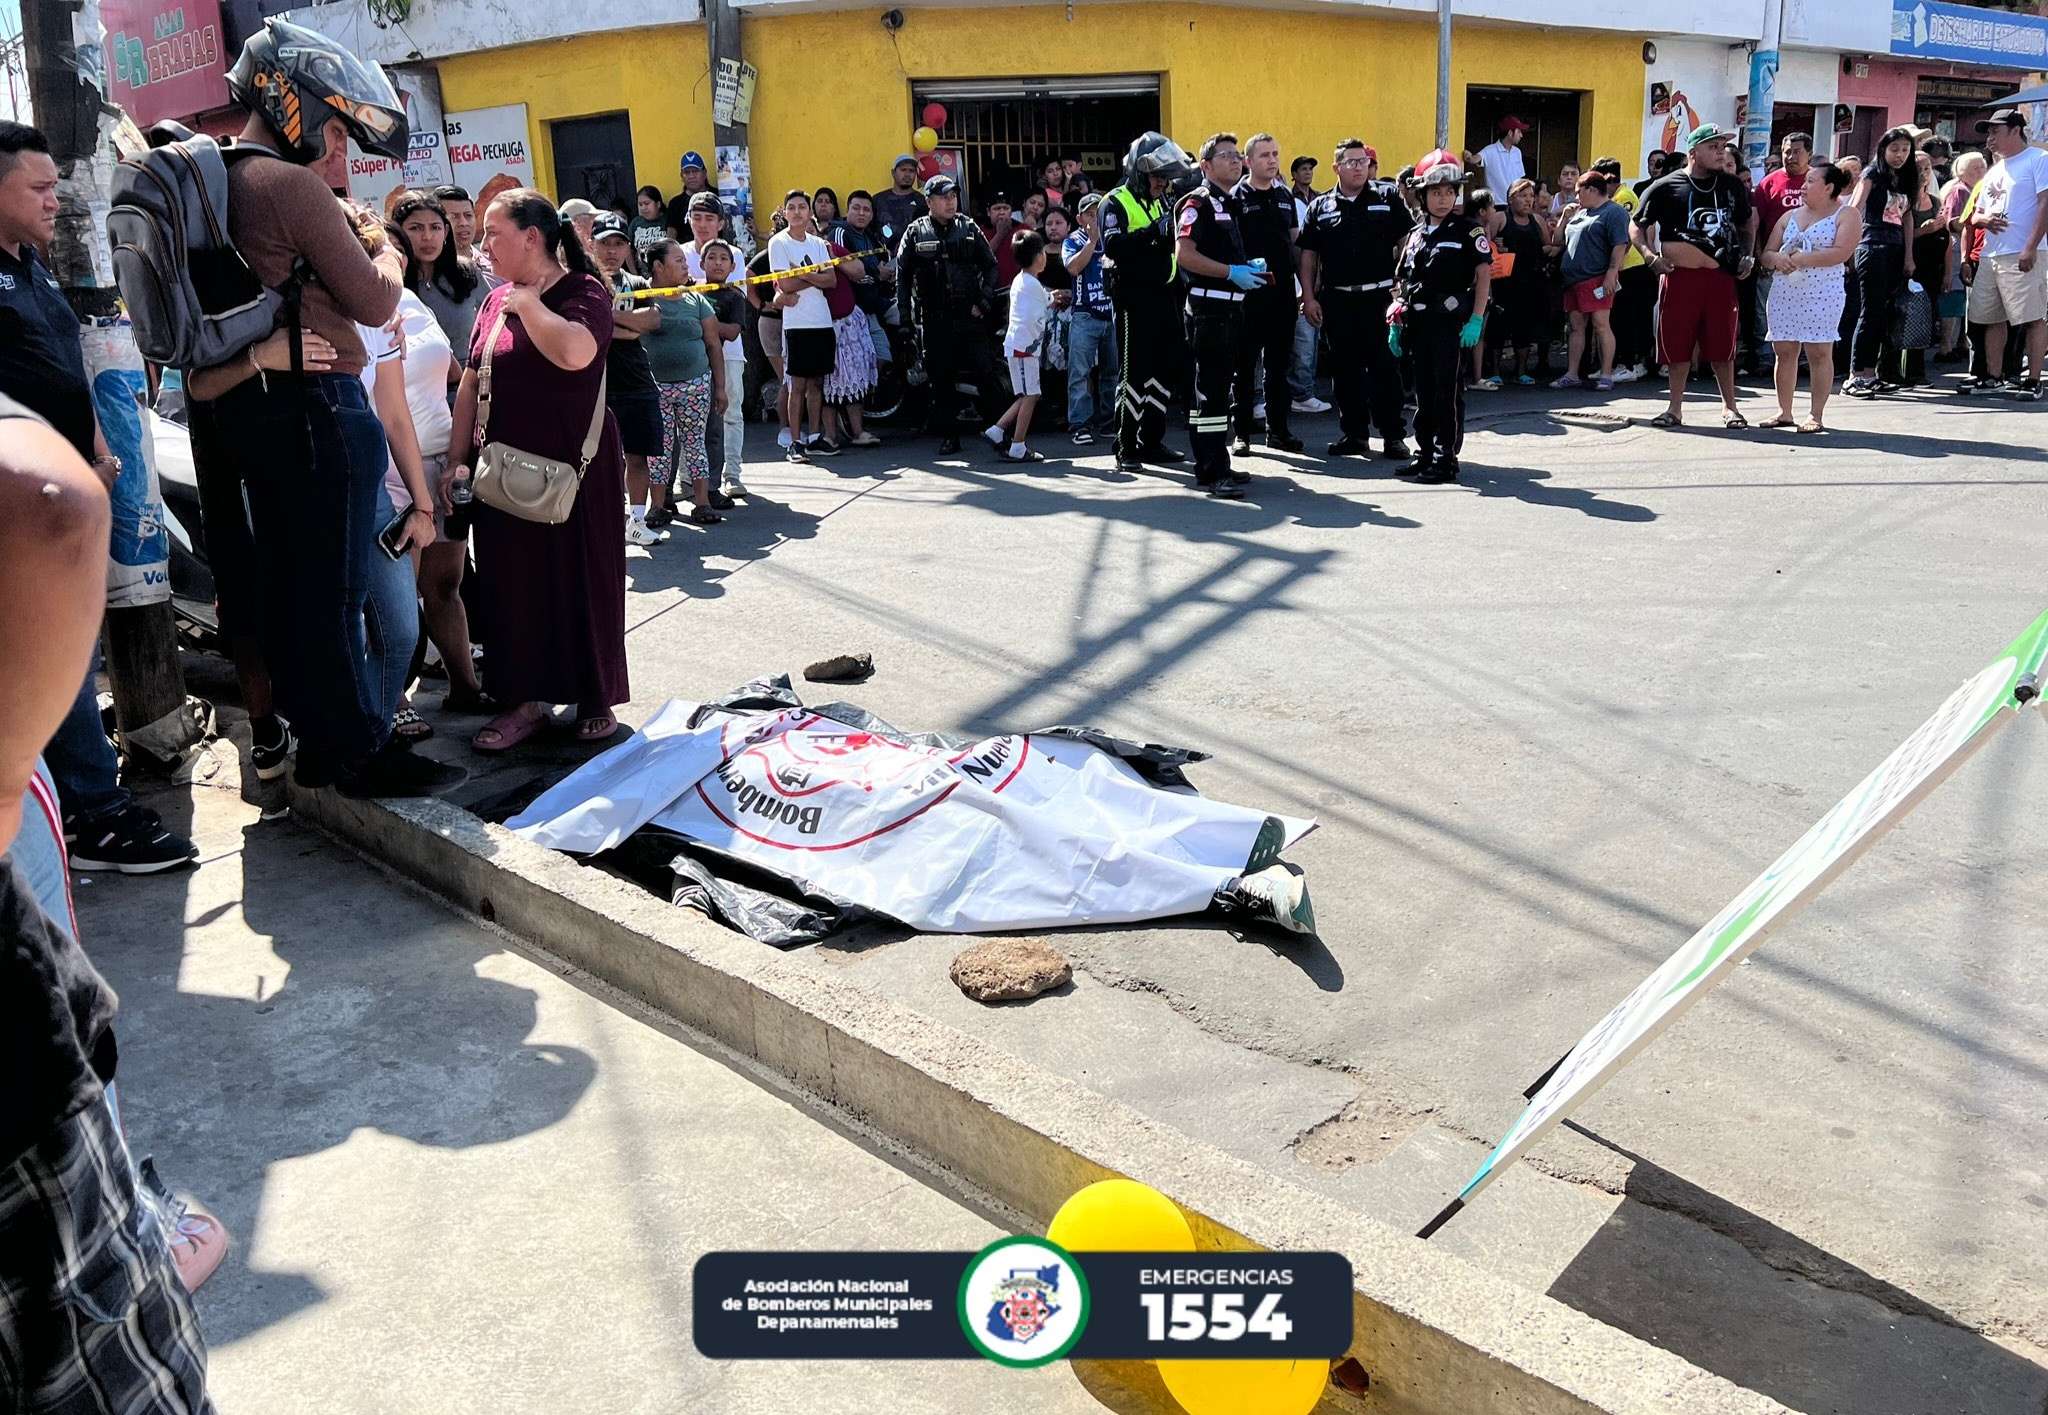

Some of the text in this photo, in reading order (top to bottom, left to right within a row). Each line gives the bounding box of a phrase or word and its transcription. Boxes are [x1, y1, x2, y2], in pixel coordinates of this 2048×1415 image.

[147, 25, 218, 83] BRASAS
[483, 141, 525, 161] PECHUGA
[505, 157, 526, 165] ASADA
[716, 761, 823, 834] Bombero
